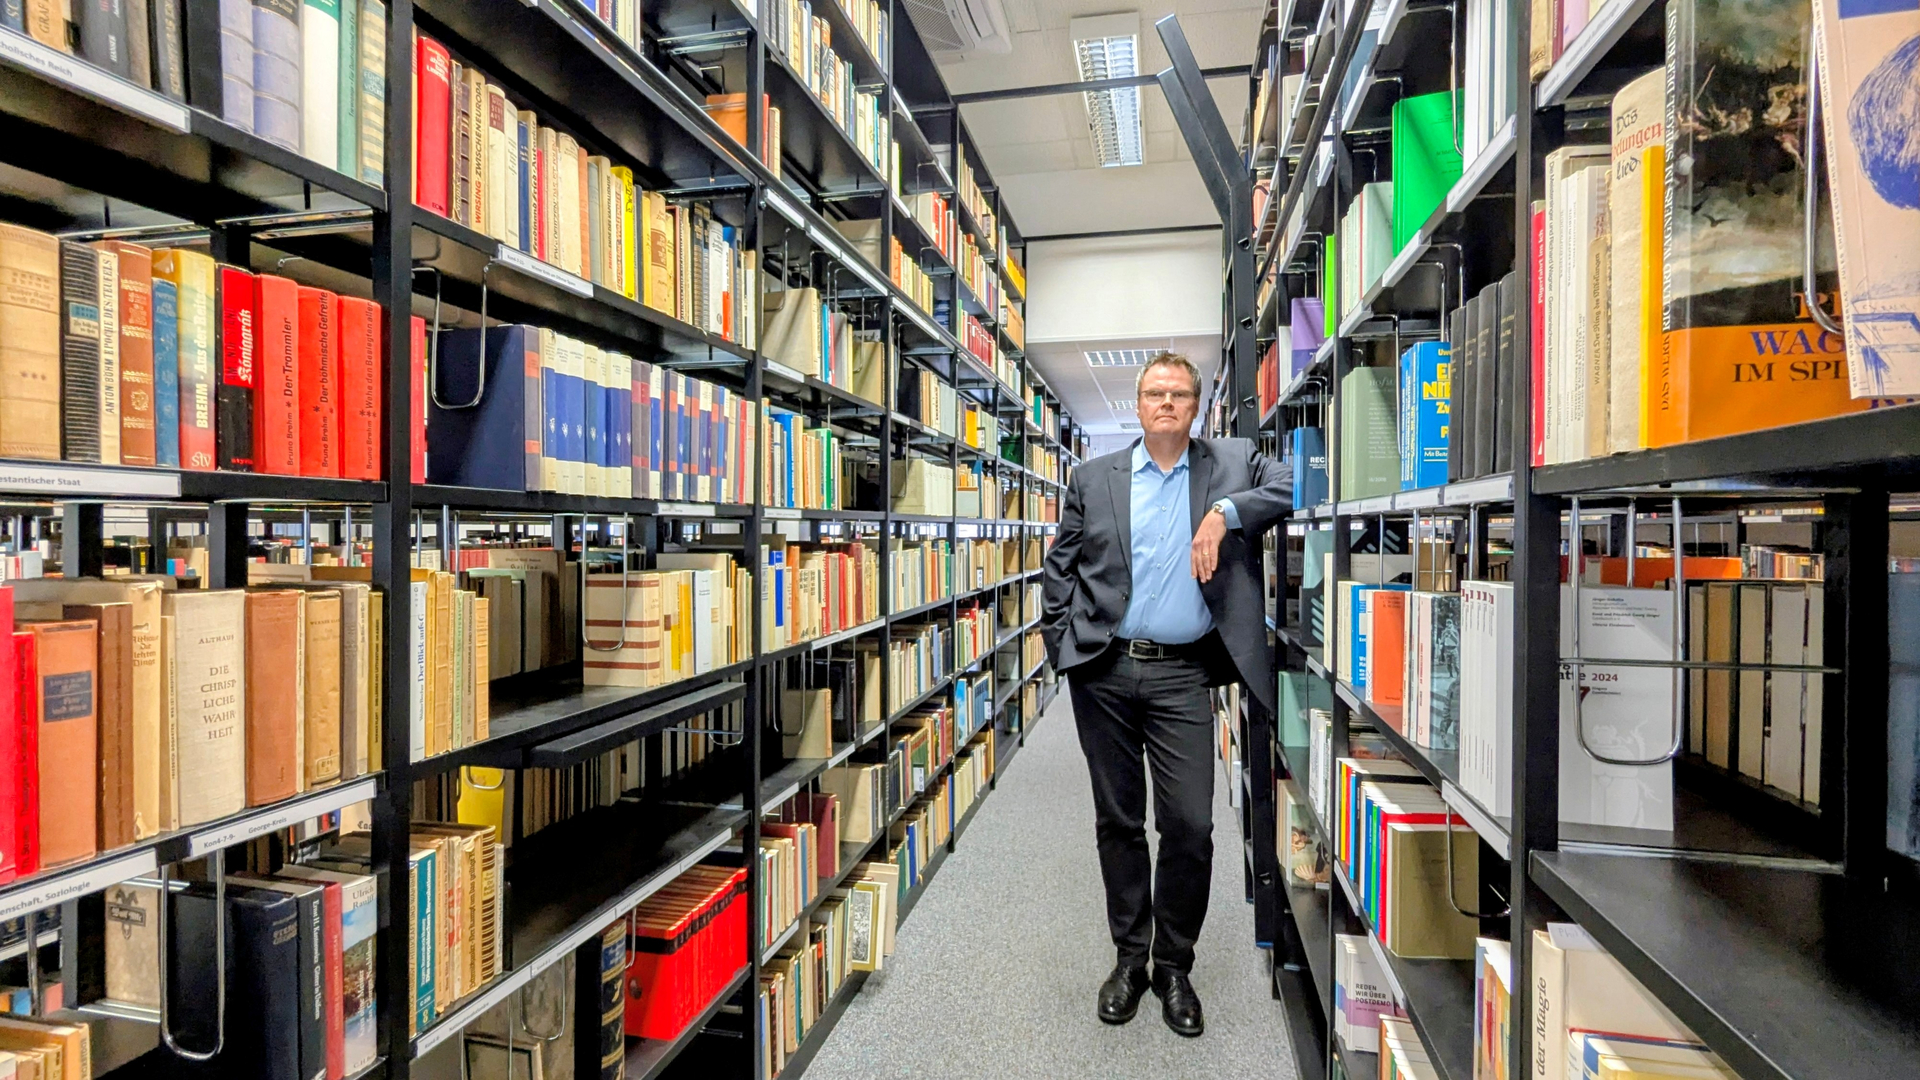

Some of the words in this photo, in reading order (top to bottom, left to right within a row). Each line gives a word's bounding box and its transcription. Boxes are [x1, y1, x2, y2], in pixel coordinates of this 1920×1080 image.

[1666, 7, 1677, 58] KUNST
[1816, 24, 1824, 62] WAGNER
[47, 59, 74, 78] Reich
[1666, 58, 1676, 94] DER
[474, 81, 482, 178] ZWISCHENEUROPA
[1616, 108, 1638, 136] Das
[1664, 94, 1675, 162] SPIEGEL
[1664, 162, 1674, 185] IM
[474, 180, 482, 224] WIRSING
[1663, 187, 1674, 261] WAGNERS
[102, 261, 113, 300] TEUFELS
[1593, 252, 1601, 298] Nibelungen
[102, 301, 113, 320] DES
[318, 291, 328, 331] Gefreite
[1662, 263, 1672, 331] RICHARD
[1843, 290, 1851, 326] VERLAG
[103, 322, 114, 357] EPOCHE
[194, 330, 207, 350] der
[282, 317, 293, 374] Trommler
[364, 323, 374, 366] Besiegten
[1748, 328, 1846, 357] WAG
[194, 351, 207, 375] Aus
[318, 331, 329, 384] böhmische
[1661, 333, 1671, 379] WERK
[102, 359, 114, 384] BÖHM
[364, 367, 373, 383] den
[1731, 361, 1776, 383] IM
[1850, 360, 1858, 389] ERICH
[283, 375, 293, 397] Der
[319, 385, 329, 404] Der
[364, 385, 373, 409] Wehe
[1661, 381, 1669, 411] DAS
[104, 387, 115, 415] ANTON
[195, 385, 209, 430] BREHM
[286, 441, 294, 466] Bruno
[321, 443, 329, 468] Bruno
[57, 477, 81, 486] Staat
[198, 634, 235, 645] ALTHAUS
[209, 665, 230, 677] DIE
[1591, 672, 1619, 682] 2024
[203, 694, 236, 709] LICHE
[207, 726, 235, 740] HEIT
[248, 817, 287, 834] George-Kreis
[45, 880, 91, 901] Soziologie
[352, 885, 374, 900] Ulrich
[1355, 983, 1377, 991] REDEN
[1369, 990, 1387, 1000] ÜBER
[1536, 976, 1550, 1041] Magie
[1535, 1042, 1546, 1076] der
